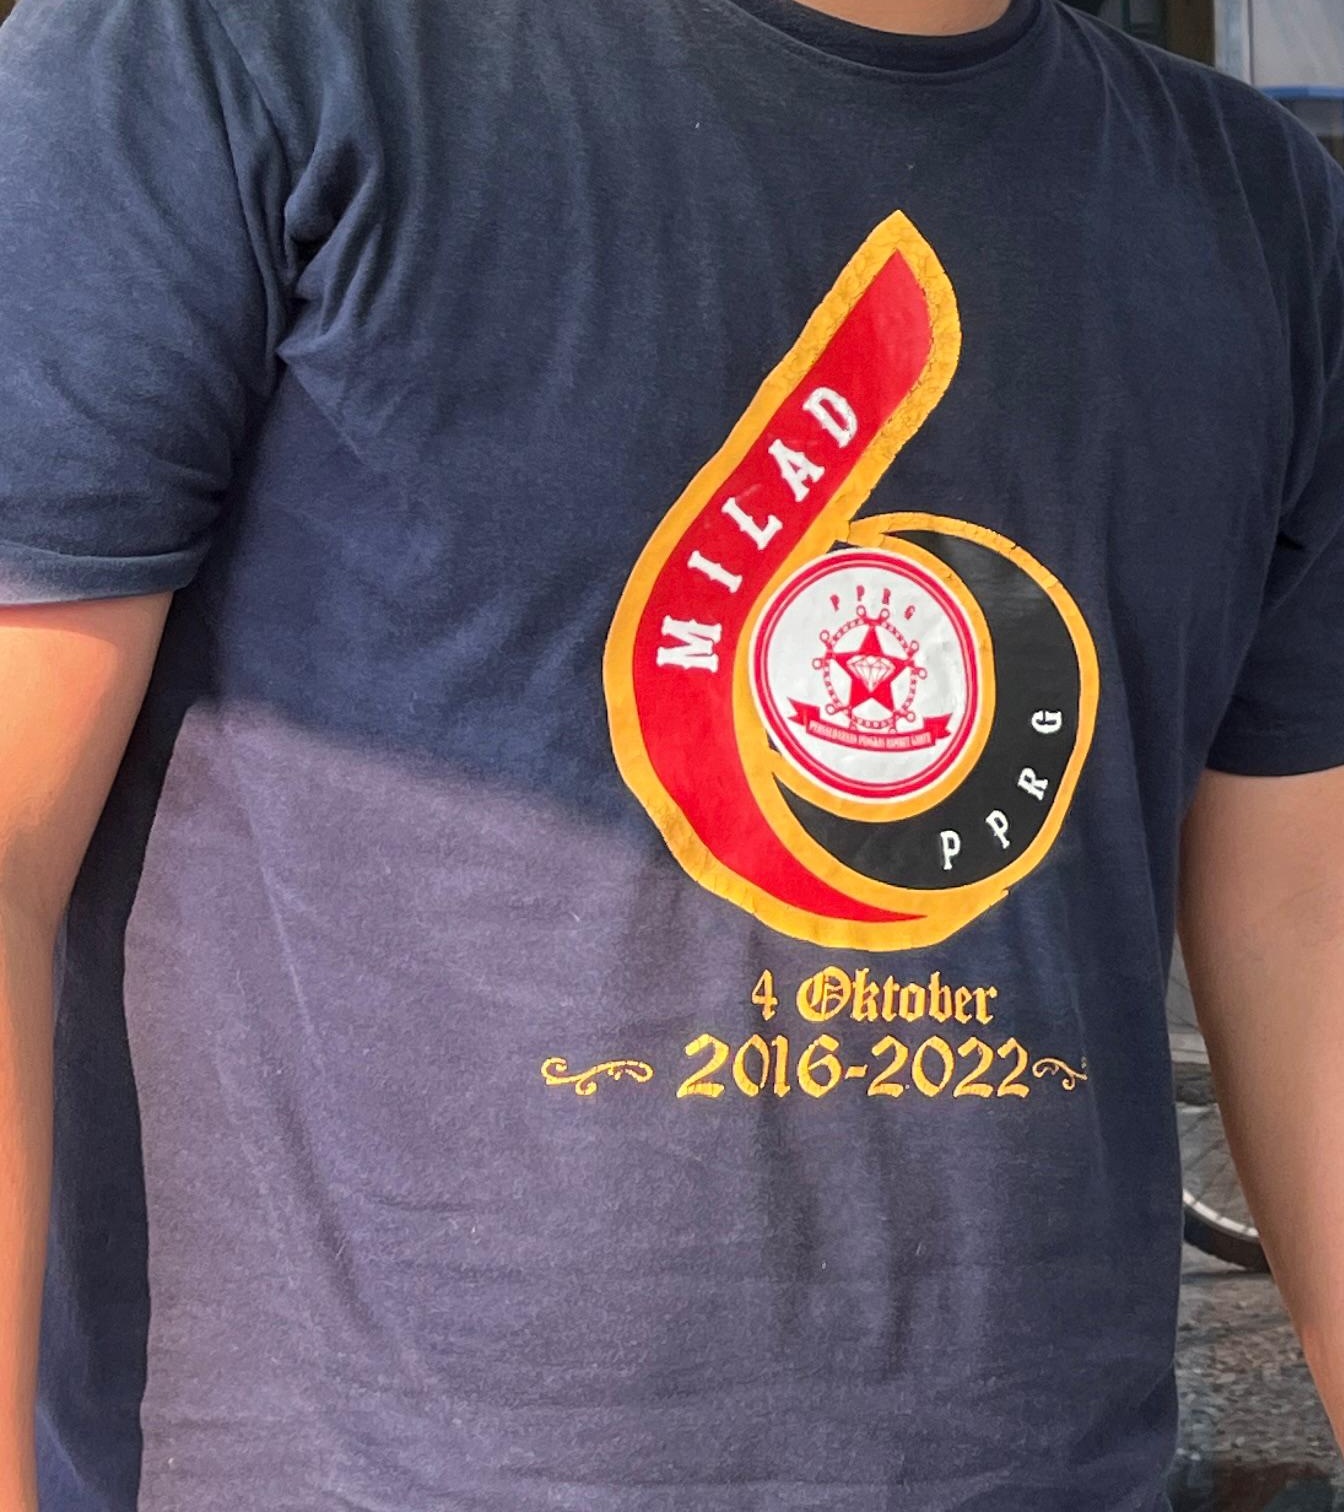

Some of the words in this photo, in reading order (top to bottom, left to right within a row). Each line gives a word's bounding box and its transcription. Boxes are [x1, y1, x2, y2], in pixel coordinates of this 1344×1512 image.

[656, 385, 859, 673] MILAD
[941, 709, 1062, 870] PPRG
[752, 969, 779, 1021] 4
[796, 966, 998, 1024] Oktober
[676, 1032, 1030, 1099] 2016-2022
